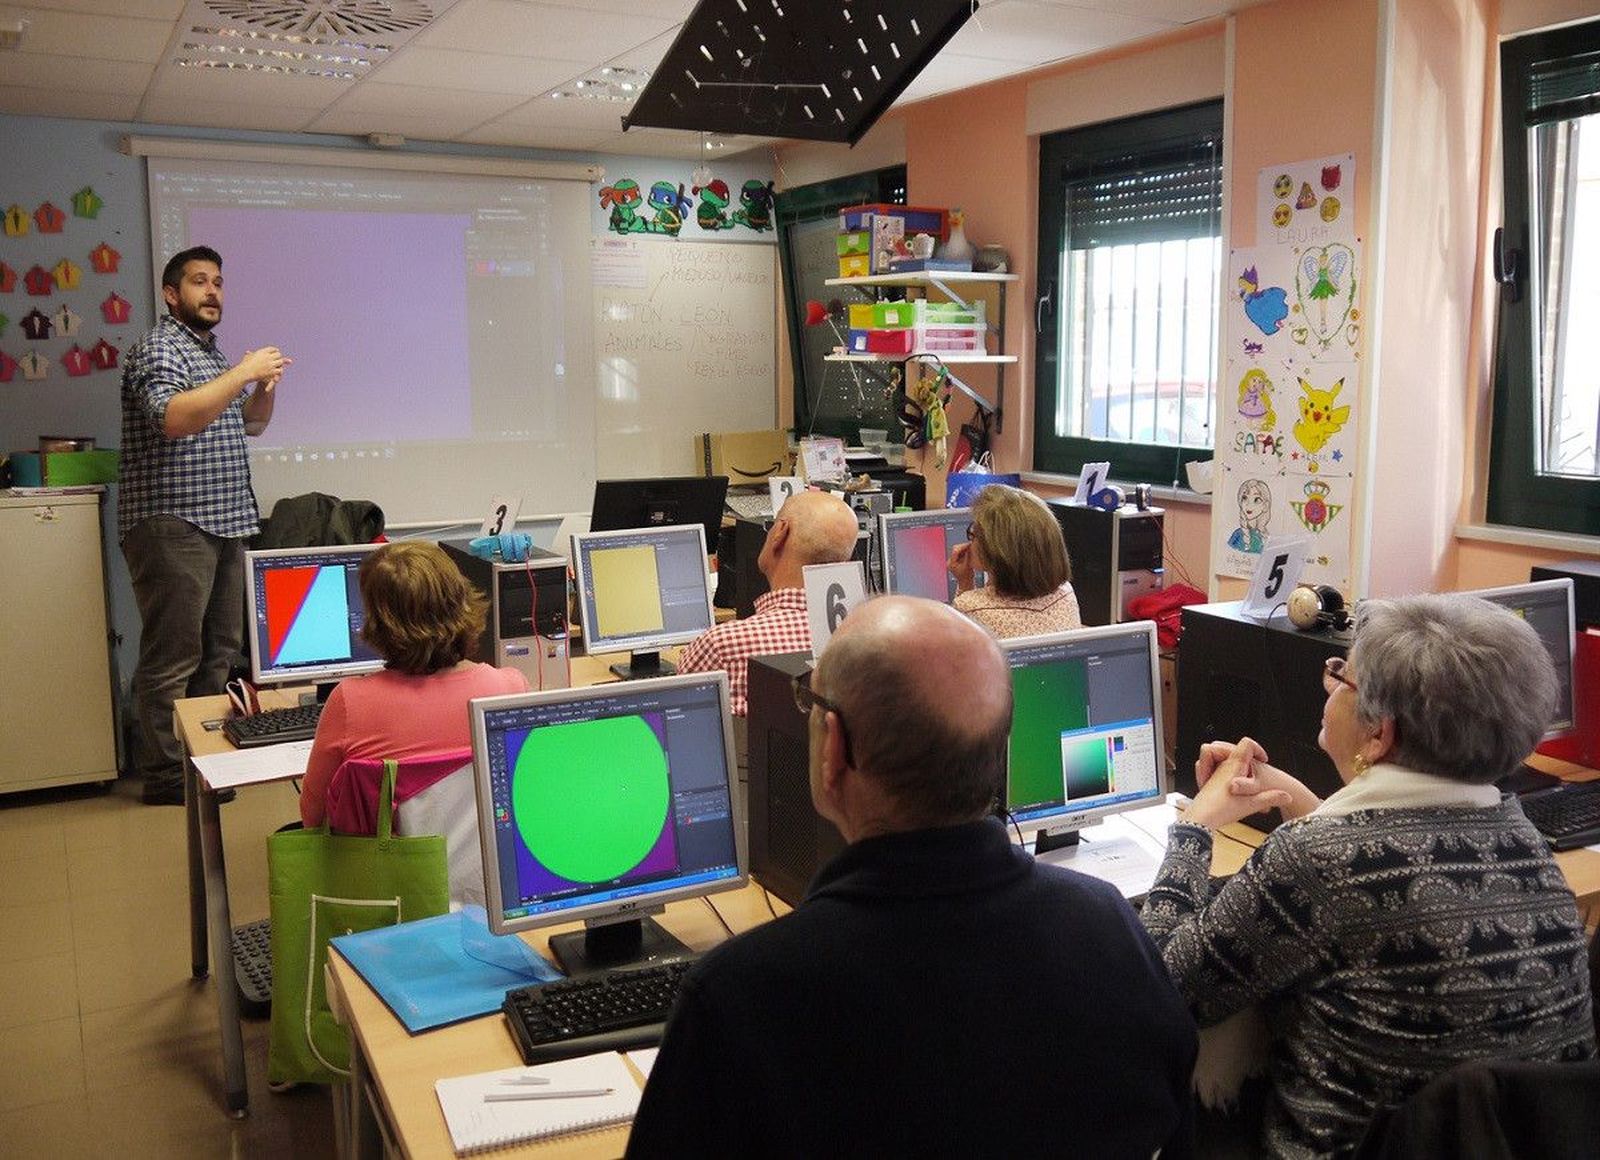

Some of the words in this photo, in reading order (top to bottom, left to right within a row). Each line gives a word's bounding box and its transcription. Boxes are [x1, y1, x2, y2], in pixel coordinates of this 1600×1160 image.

[1086, 471, 1098, 498] 1
[489, 505, 507, 536] 3
[1265, 553, 1289, 599] 5
[826, 583, 848, 634] 6
